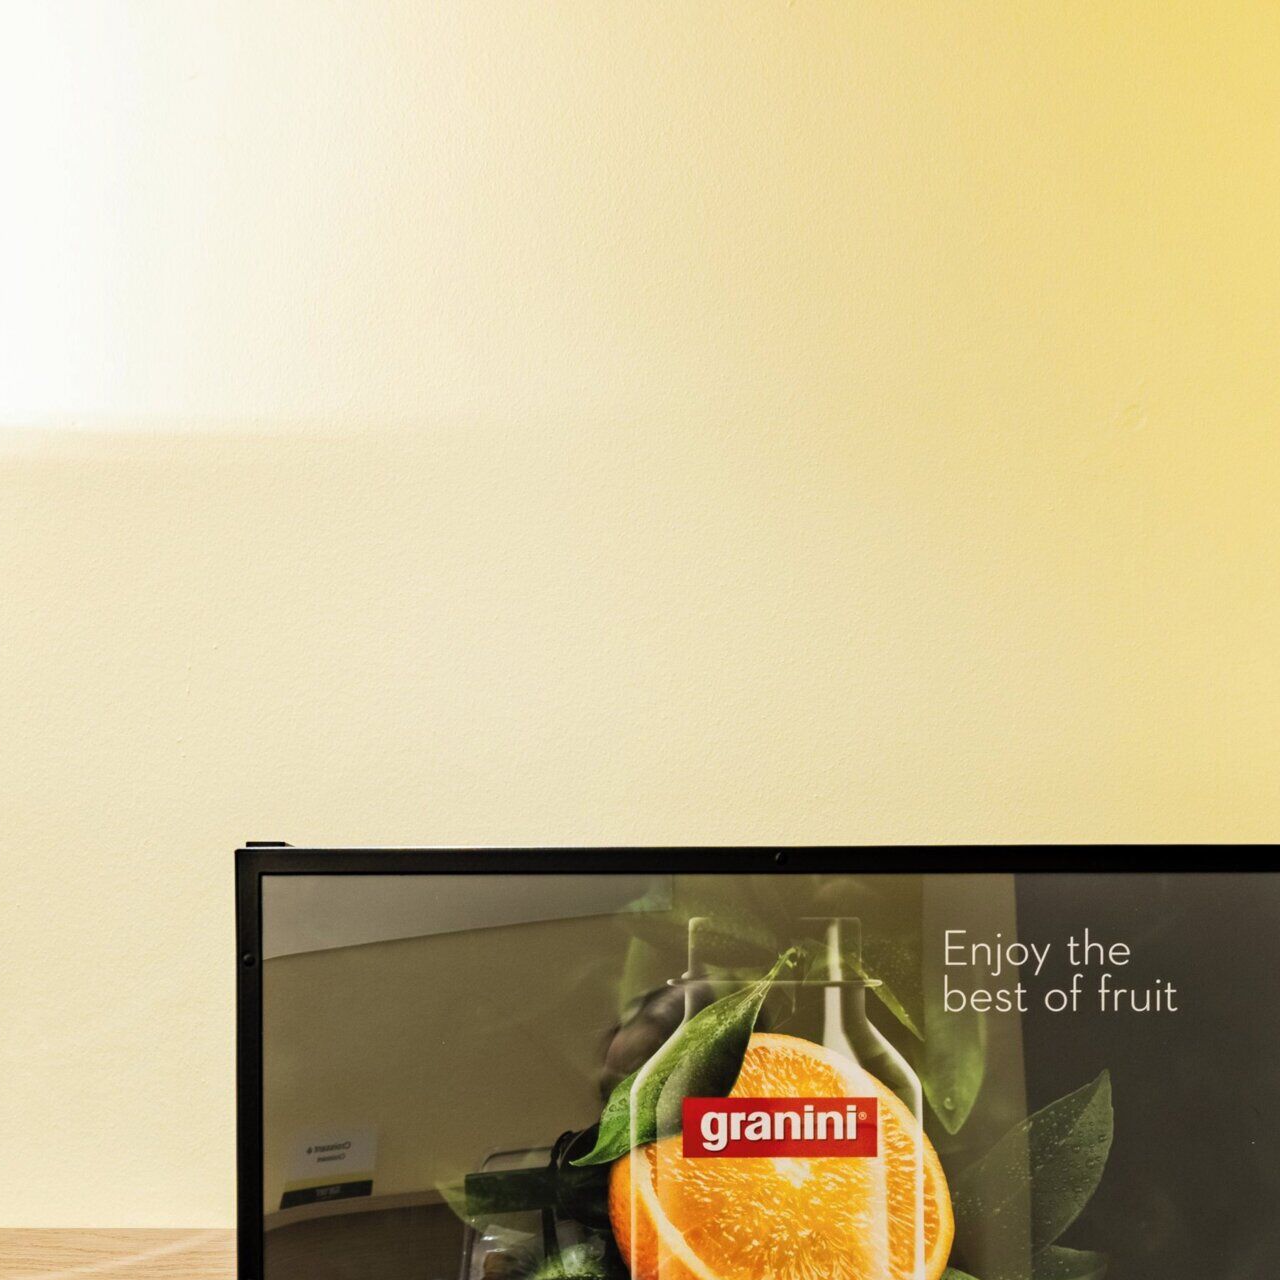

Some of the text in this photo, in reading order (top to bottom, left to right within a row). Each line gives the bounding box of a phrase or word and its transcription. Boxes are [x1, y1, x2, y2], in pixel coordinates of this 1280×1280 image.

[943, 928, 1131, 976] Enjoy the
[943, 973, 1179, 1013] best of fruit
